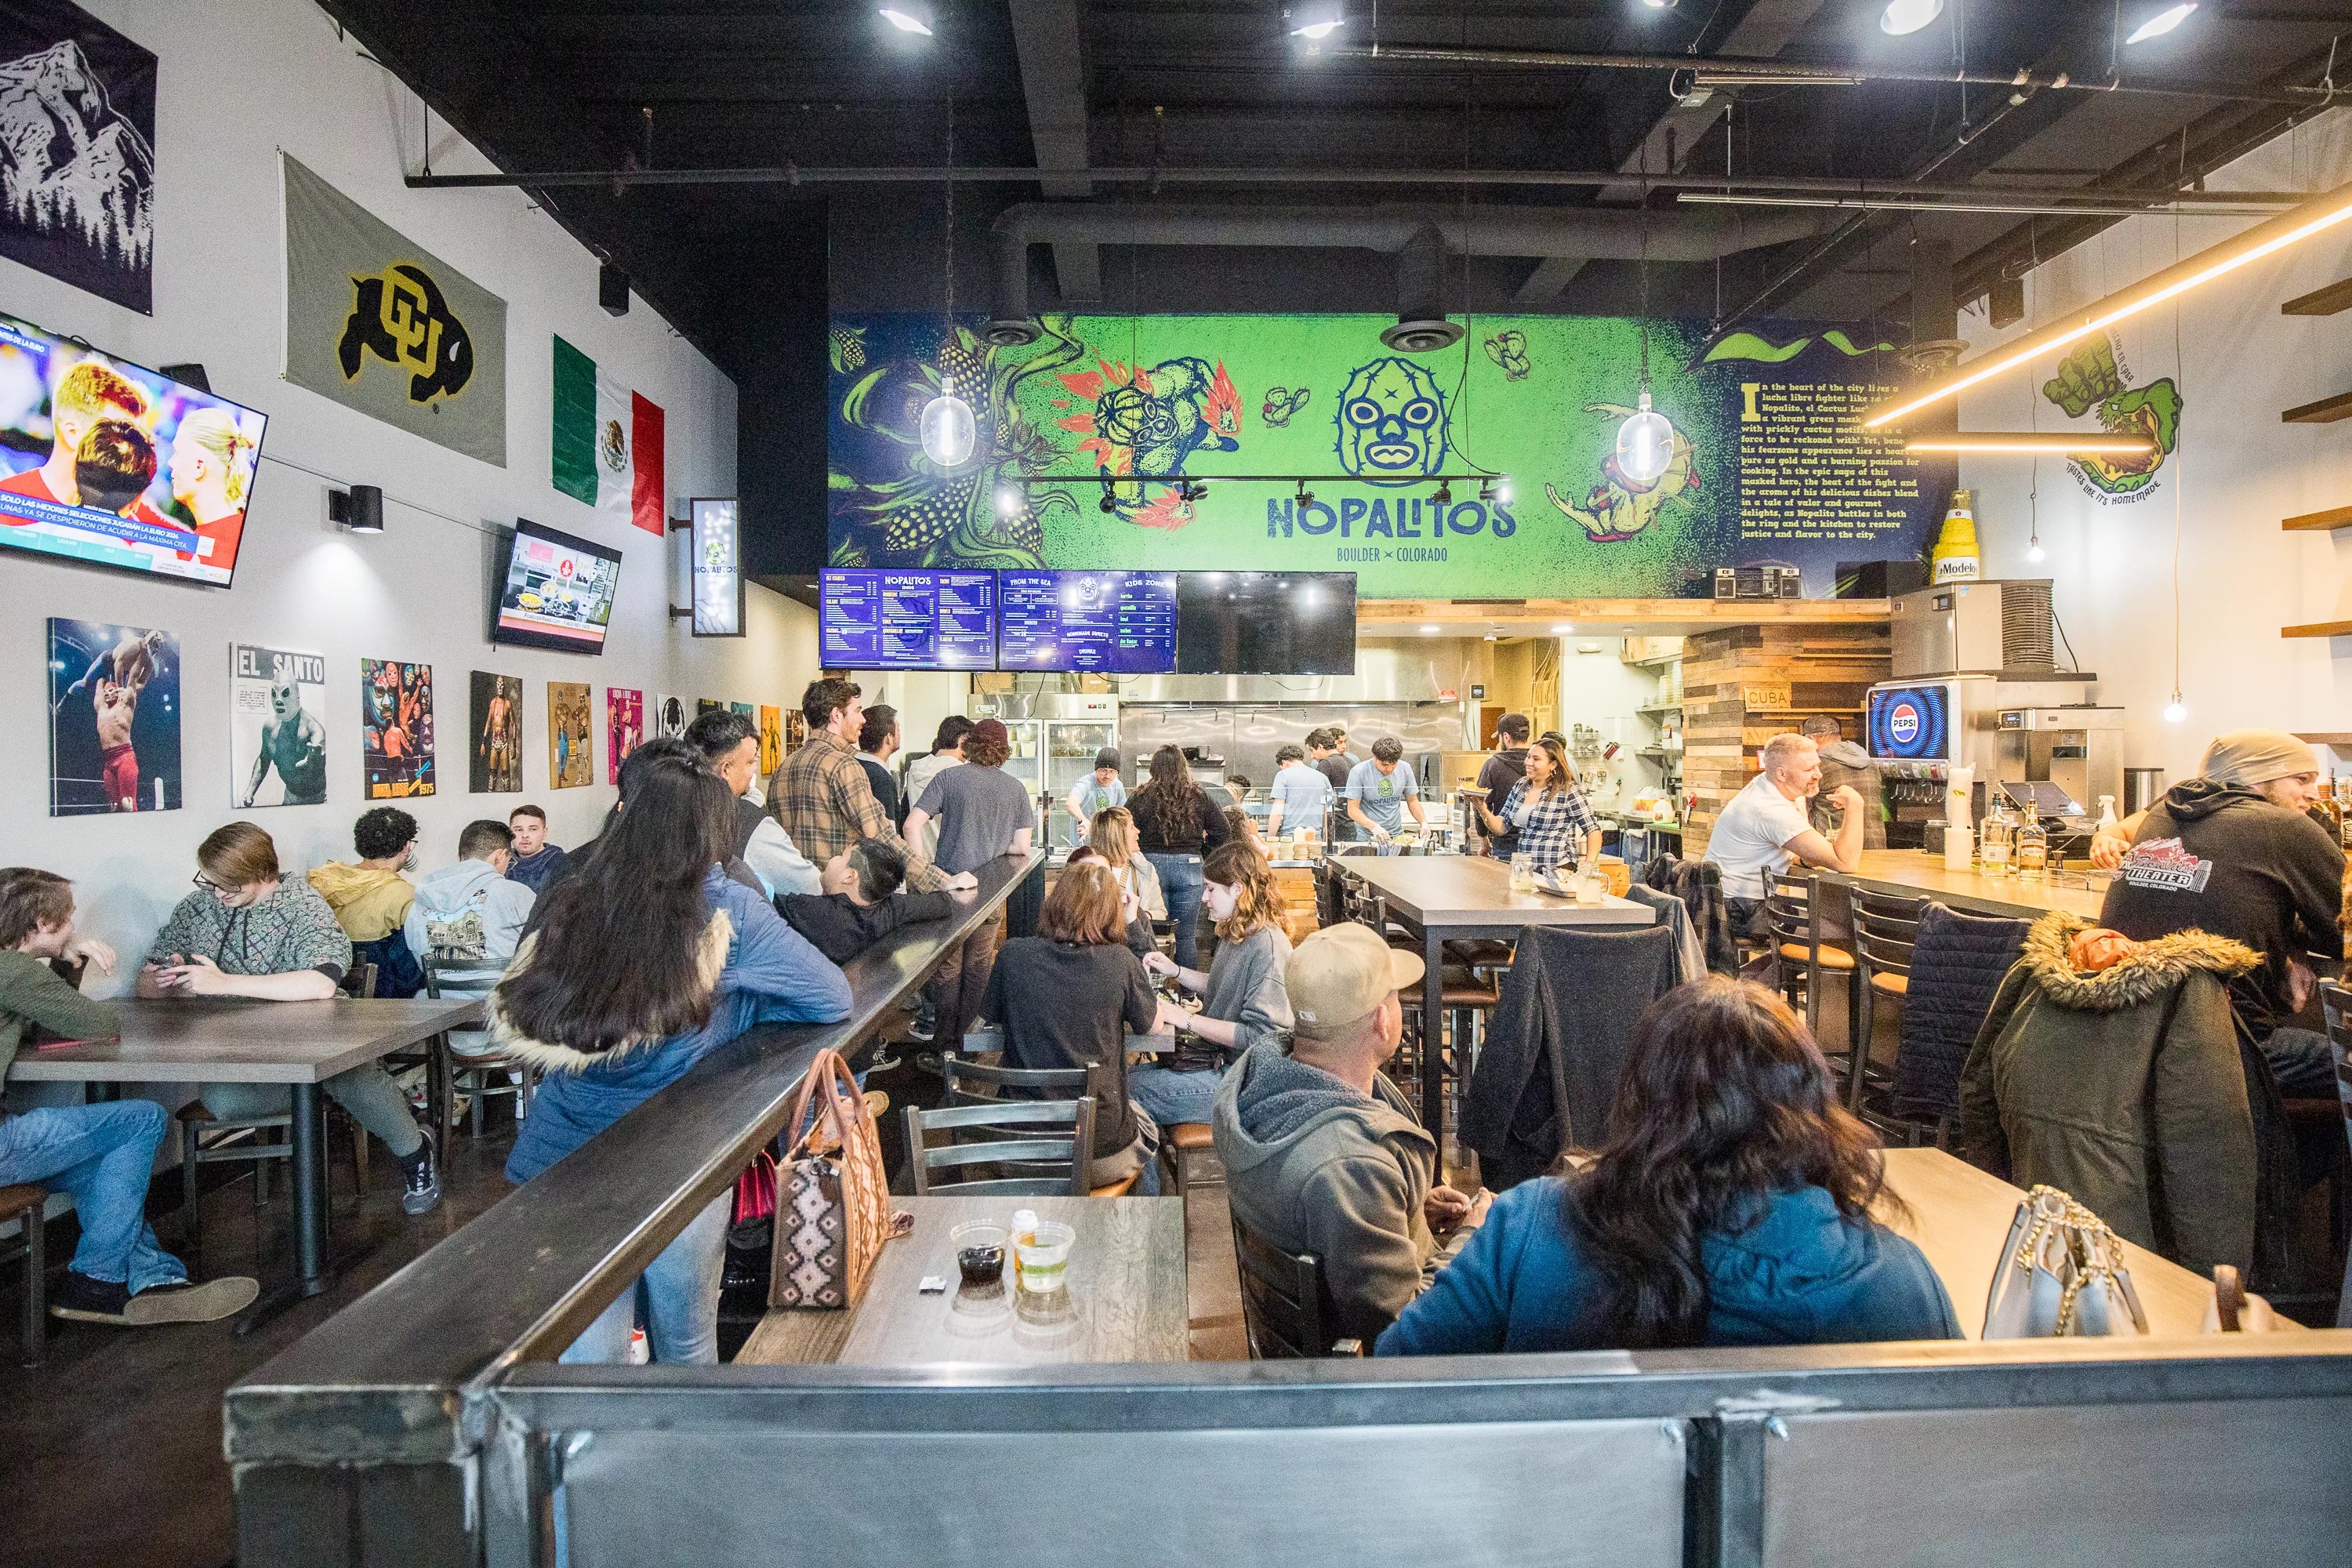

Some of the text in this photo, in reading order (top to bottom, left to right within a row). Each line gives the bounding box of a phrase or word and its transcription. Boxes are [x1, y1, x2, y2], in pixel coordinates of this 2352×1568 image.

[30, 341, 45, 353] EURO
[2118, 352, 2125, 363] EN
[2120, 363, 2135, 383] CASA
[1847, 384, 1864, 394] city
[1815, 394, 1846, 404] fighter
[1762, 404, 1803, 414] Nopalito,
[1809, 416, 1835, 424] green
[1766, 425, 1800, 434] prickly
[1835, 425, 1867, 434] motifs,
[1864, 436, 1880, 445] Yet,
[1741, 458, 1762, 466] pure
[1778, 457, 1798, 466] gold
[1831, 457, 1866, 466] burning
[1870, 457, 1904, 467] passion
[1741, 466, 1779, 477] cooking.
[1813, 467, 1831, 477] epic
[1875, 478, 1896, 488] fight
[2067, 463, 2085, 485] TASTES
[2082, 484, 2096, 498] LIKE
[2111, 480, 2161, 506] HOMEMADE
[1845, 499, 1882, 509] gourmet
[0, 494, 21, 503] SOLO
[22, 499, 36, 508] LAS
[36, 503, 69, 515] MEJORES
[69, 508, 112, 524] SELECCIONES
[111, 518, 141, 531] JUGARÁN
[150, 527, 165, 537] EURO
[1267, 498, 1516, 539] NOPALITO'S
[1741, 509, 1781, 519] delights,
[1798, 510, 1835, 519] Nopalito
[1759, 519, 1779, 529] ring
[47, 513, 96, 529] DESPIDIERON
[108, 526, 133, 538] ACUDIR
[149, 534, 172, 546] MÁXIMA
[1741, 529, 1772, 539] justice
[1857, 530, 1876, 539] city.
[1337, 547, 1448, 562] BOULDER COLORADO
[1943, 562, 1976, 575] Modelo
[238, 649, 323, 682] EL SANTO
[1749, 691, 1788, 705] CUBA
[1893, 719, 1916, 728] PEPSI
[419, 782, 434, 795] 1975
[2129, 869, 2190, 885] THEATER
[2149, 883, 2178, 892] COLORADO
